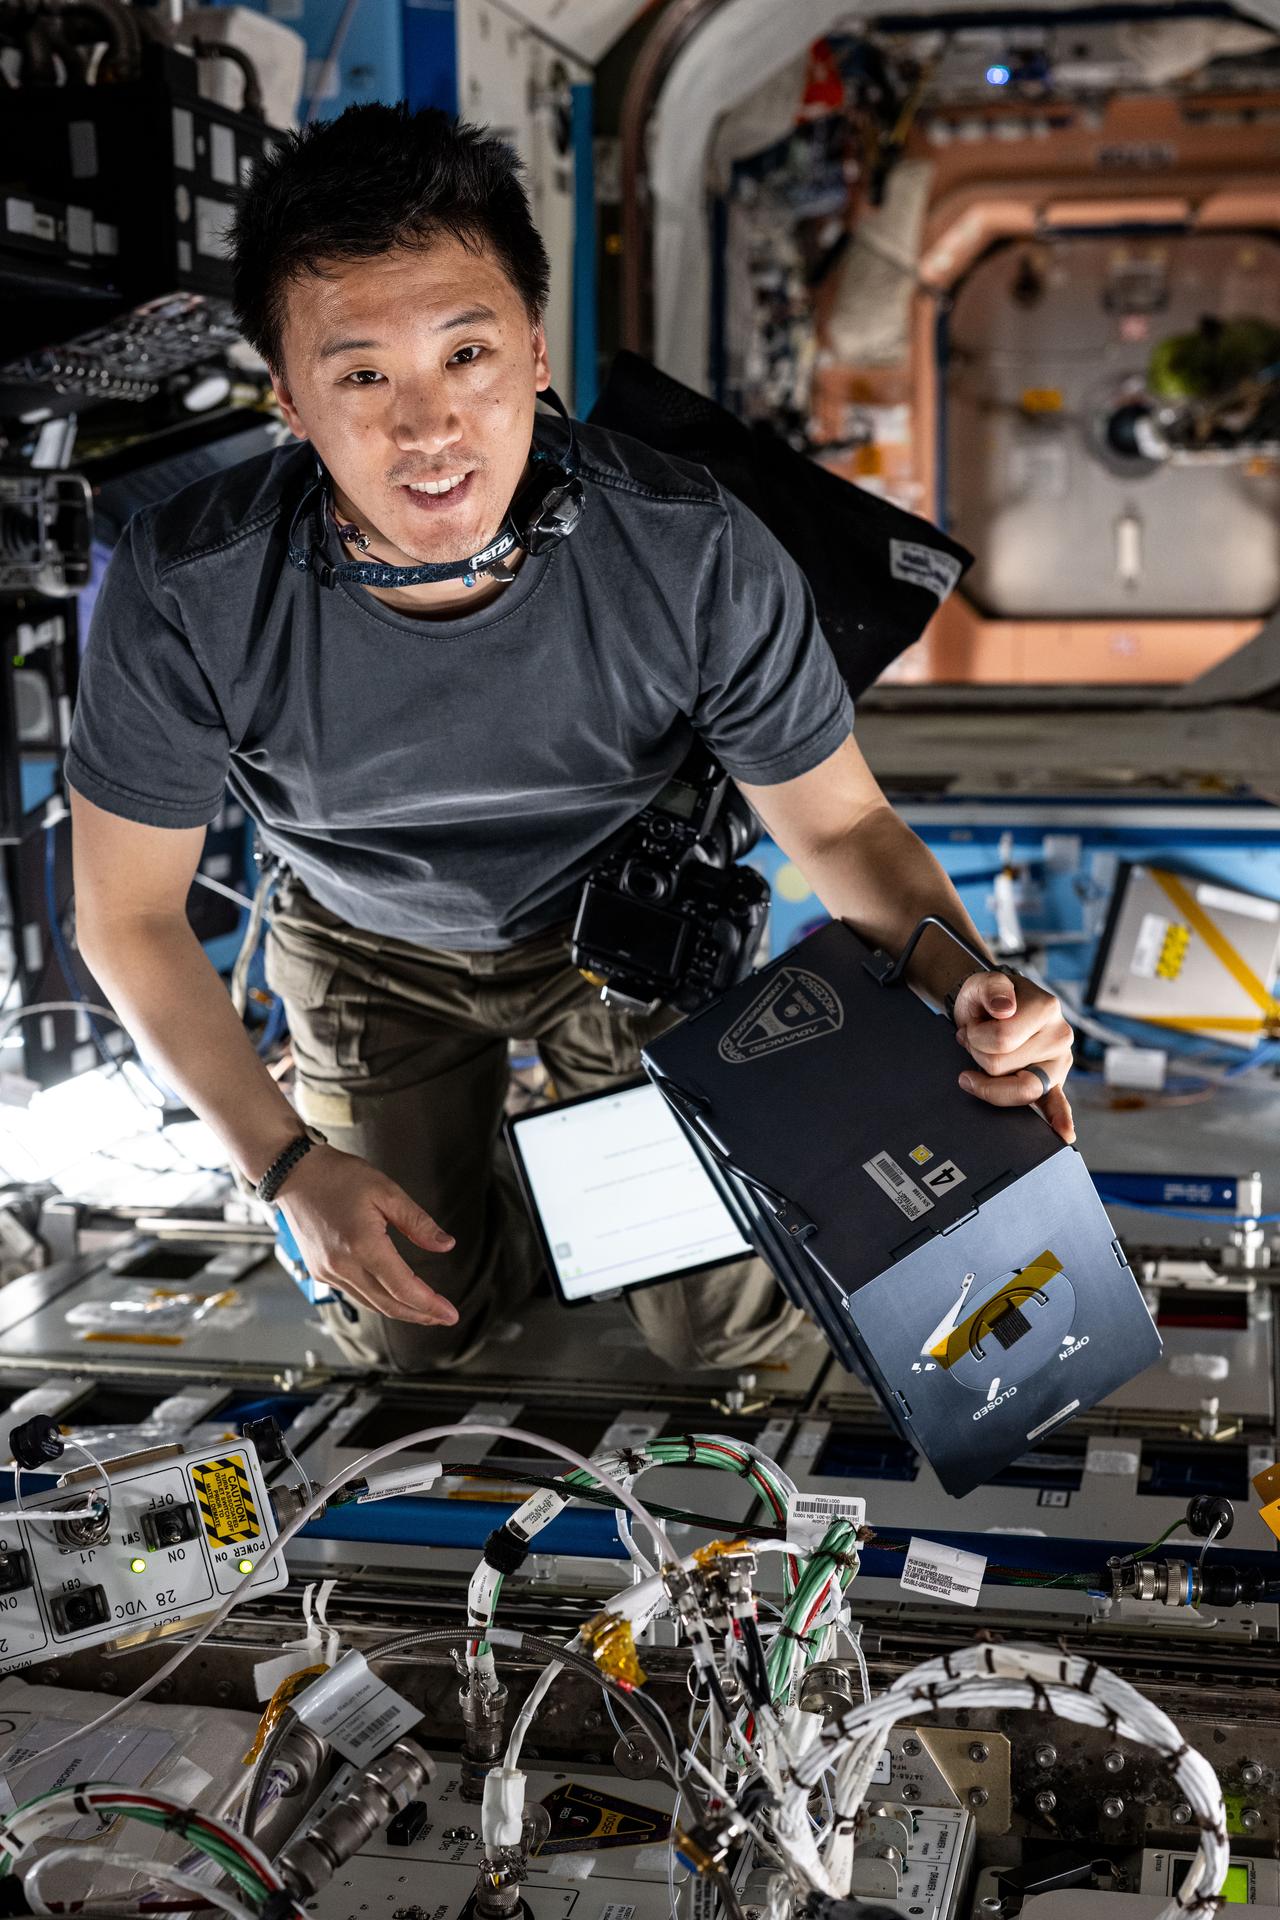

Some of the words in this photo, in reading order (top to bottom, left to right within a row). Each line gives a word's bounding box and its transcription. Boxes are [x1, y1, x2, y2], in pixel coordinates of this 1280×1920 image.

[472, 537, 513, 569] PETZL
[360, 570, 420, 582] TIKKA
[722, 1036, 746, 1060] SPACE
[748, 1026, 818, 1054] ADVANCED
[928, 1166, 955, 1187] 4
[1058, 1336, 1090, 1360] OPEN
[972, 1386, 1017, 1420] CLOSED
[206, 1483, 214, 1500] MATE
[215, 1472, 224, 1496] OUTLET
[221, 1496, 230, 1520] SWITCH
[228, 1476, 247, 1523] CAUTION
[148, 1494, 174, 1511] OFF
[214, 1490, 222, 1508] PRIOR
[219, 1508, 224, 1518] TO
[221, 1474, 229, 1490] TURN
[225, 1491, 238, 1528] ASSOCIATED
[122, 1532, 141, 1546] SW1
[80, 1550, 96, 1564] J1
[168, 1548, 186, 1563] ON
[215, 1552, 228, 1563] ON
[234, 1541, 265, 1557] POWER
[925, 1569, 937, 1577] POWER
[62, 1578, 81, 1592] CB1
[939, 1586, 951, 1595] CABLE
[156, 1590, 176, 1606] 28
[115, 1600, 147, 1618] VDC
[446, 1780, 458, 1793] DATA
[450, 1842, 469, 1860] STATUS
